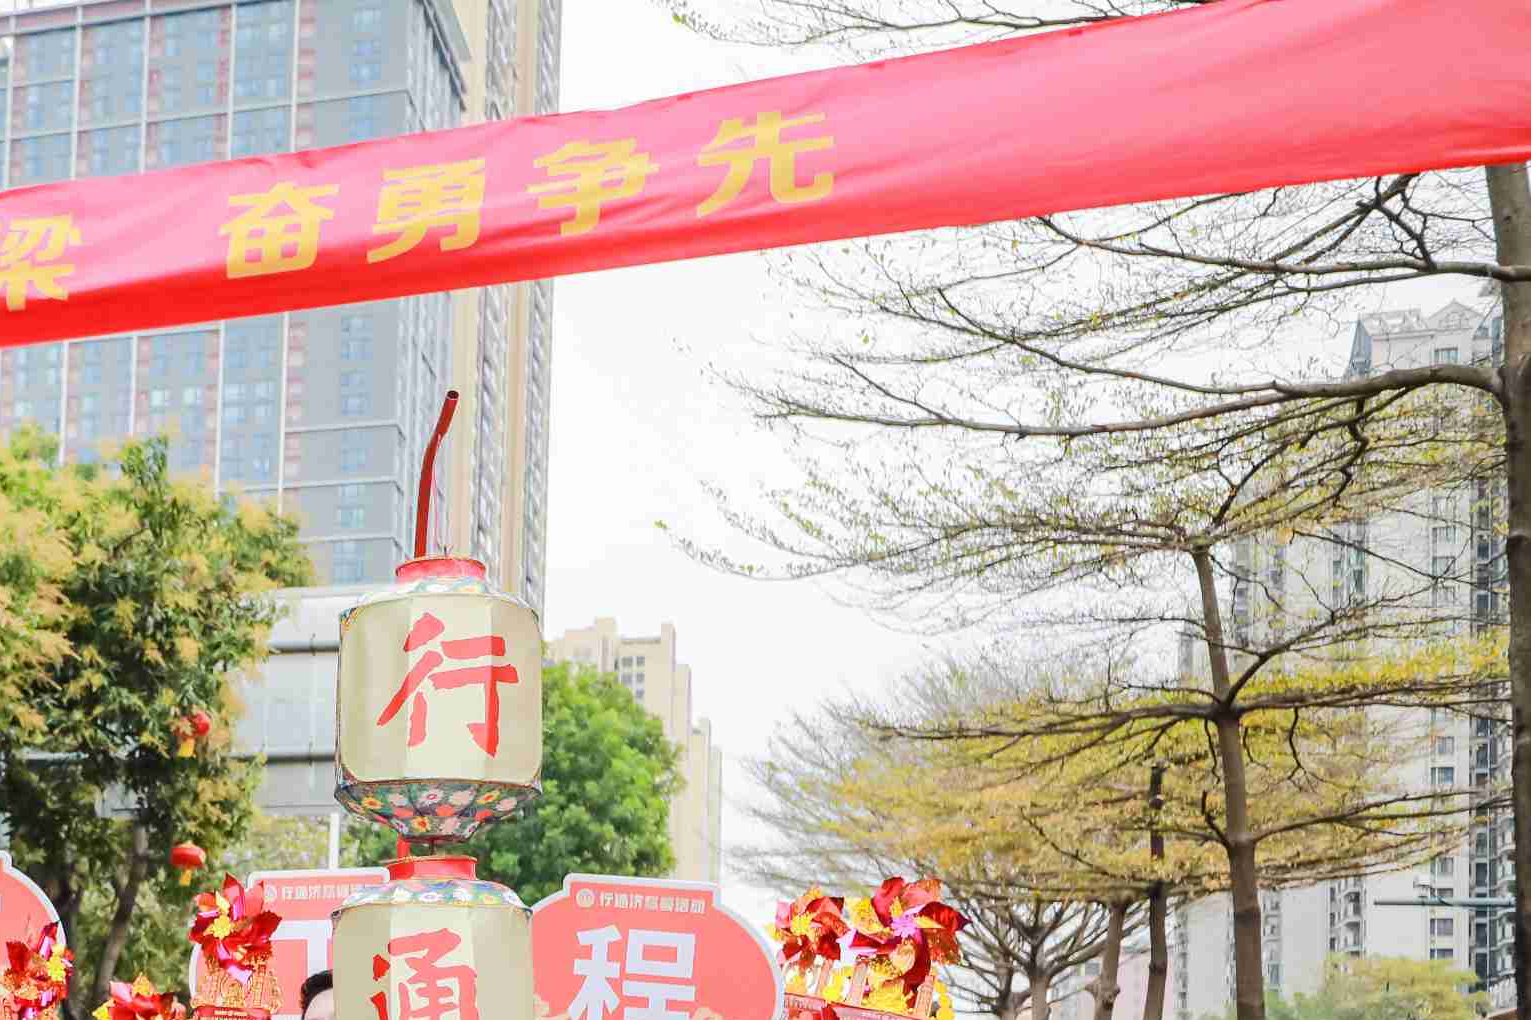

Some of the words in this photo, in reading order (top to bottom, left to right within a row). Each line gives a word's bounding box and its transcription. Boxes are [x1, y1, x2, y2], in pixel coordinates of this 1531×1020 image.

[221, 112, 835, 279] 奋勇争先
[377, 613, 518, 758] 行
